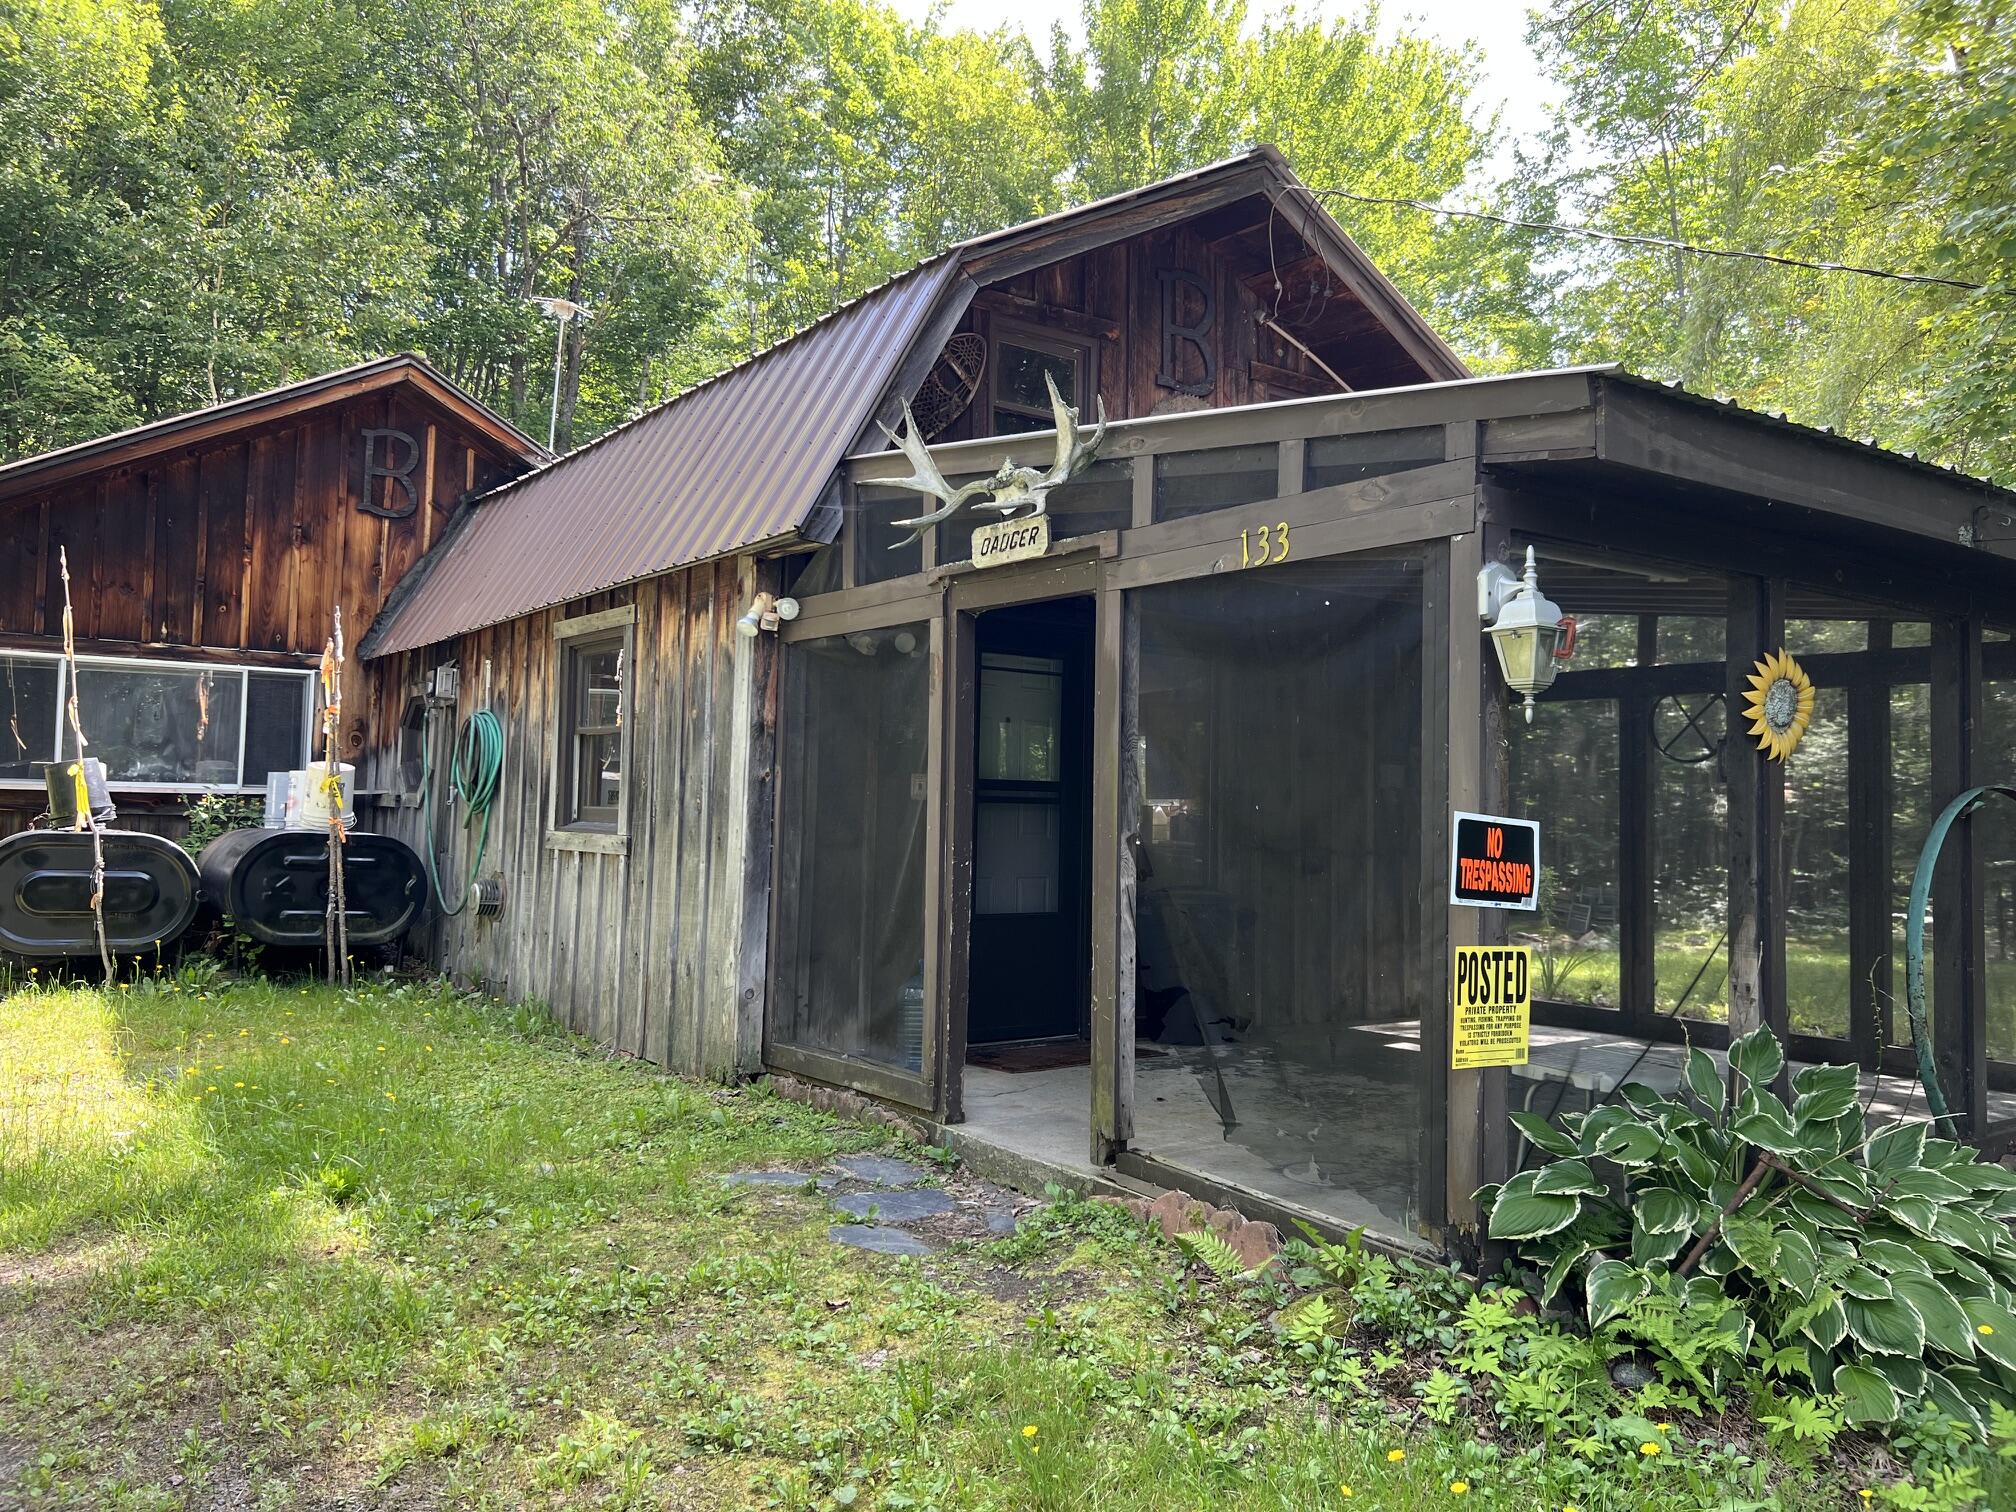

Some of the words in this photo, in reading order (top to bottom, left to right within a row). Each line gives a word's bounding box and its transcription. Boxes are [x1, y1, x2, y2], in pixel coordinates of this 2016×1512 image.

[1155, 269, 1216, 398] B
[357, 428, 419, 518] B
[1241, 522, 1290, 570] 133
[1487, 827, 1503, 858] NO
[1460, 858, 1531, 894] TRESPASSING
[1457, 951, 1528, 1006] POSTED
[1460, 1023, 1485, 1031] TRESPASSING
[1465, 1005, 1486, 1016] PRIVATE
[1488, 1005, 1517, 1015] PROPERTY
[1459, 1039, 1479, 1047] VIOLATORS
